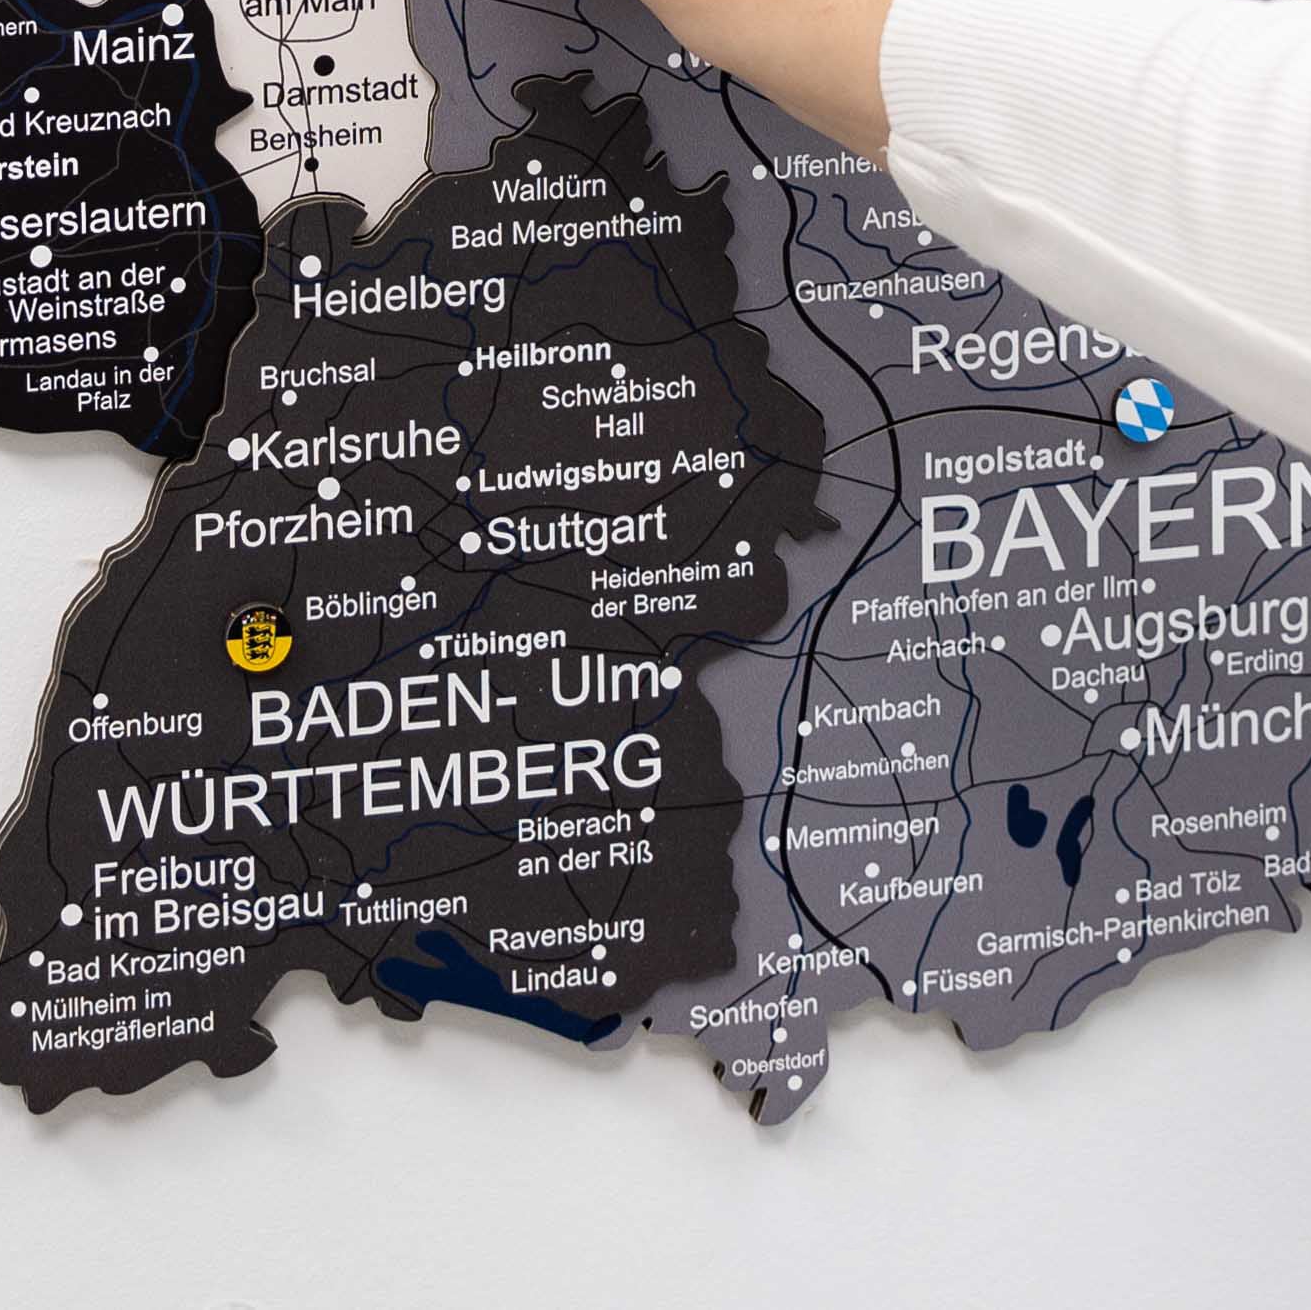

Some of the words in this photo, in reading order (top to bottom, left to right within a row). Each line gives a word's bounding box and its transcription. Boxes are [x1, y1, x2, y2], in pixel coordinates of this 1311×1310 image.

[74, 27, 194, 66] Mainz
[262, 77, 418, 109] Darmstadt
[26, 103, 170, 135] Kreuznach
[79, 269, 111, 290] an
[121, 262, 165, 287] der
[9, 289, 165, 322] Weinstraße
[295, 275, 504, 318] Heidelberg
[27, 369, 105, 392] Landau
[114, 366, 131, 384] in
[140, 363, 174, 383] der
[78, 390, 130, 411] Pfalz
[252, 420, 460, 471] Karlsruhe
[926, 440, 1085, 483] Ingolstadt
[480, 459, 660, 492] Ludwigsburg
[488, 505, 667, 555] Stuttgart
[592, 561, 720, 590] Heidenheim
[728, 562, 753, 577] an
[592, 598, 626, 617] der
[635, 595, 696, 614] Brenz
[852, 588, 1008, 624] Pfaffenhofen
[1016, 588, 1046, 607] an
[1055, 580, 1094, 603] der
[1103, 575, 1137, 599] Ilm
[1063, 595, 1308, 659] Augsburg
[552, 654, 658, 706] Ulm
[252, 670, 516, 746] BADEN-
[782, 750, 948, 785] Schwabmünchen
[98, 734, 661, 846] WÜRTTEMBERG
[519, 809, 634, 846] Biberach
[519, 857, 548, 876] an
[559, 848, 601, 871] der
[610, 840, 653, 866] Riß
[95, 856, 254, 899] Freiburg
[95, 907, 138, 940] im
[155, 891, 323, 933] Breisgau
[977, 905, 1268, 955] Garmisch-Partenkirchen
[48, 956, 99, 984] Bad
[111, 946, 244, 977] Krozingen
[512, 965, 597, 993] Lindau
[32, 993, 135, 1025] Müllheim
[146, 989, 171, 1009] im
[33, 1012, 213, 1051] Markgräflerland
[732, 1049, 825, 1076] Oberstdorf
